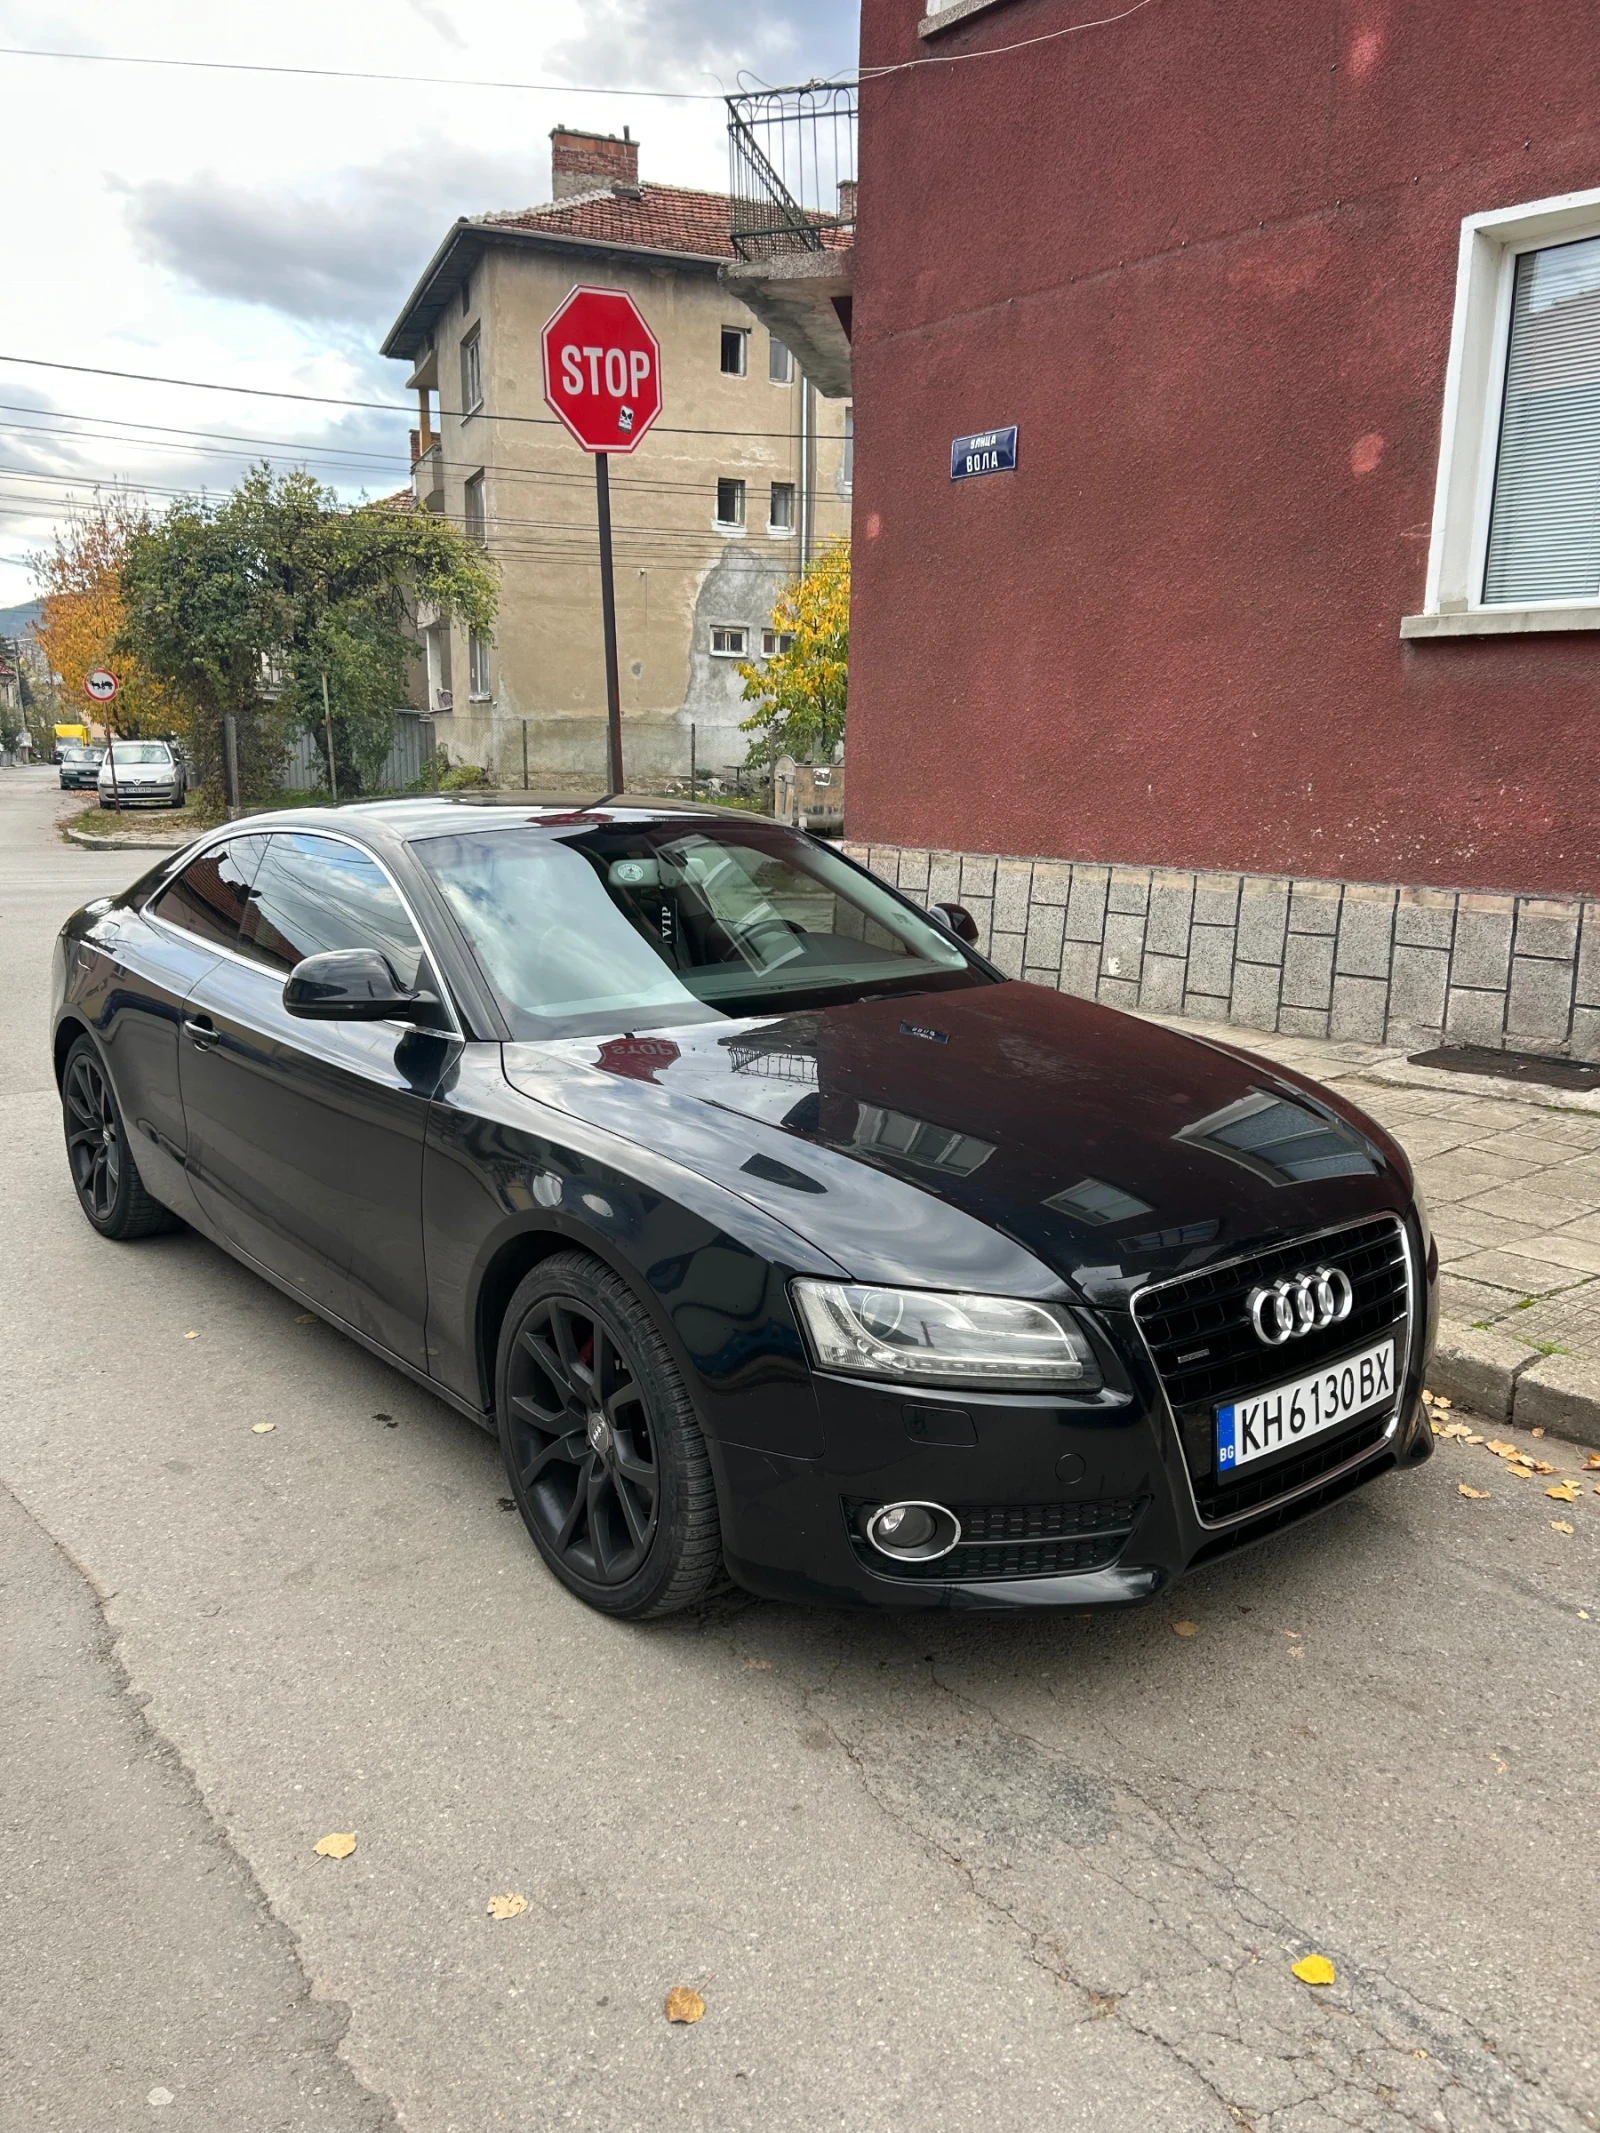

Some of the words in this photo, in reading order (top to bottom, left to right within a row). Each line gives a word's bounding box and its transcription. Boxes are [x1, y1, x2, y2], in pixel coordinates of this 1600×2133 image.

[561, 345, 650, 398] STOP
[966, 451, 999, 473] ВОЛА
[1220, 1445, 1234, 1463] BG
